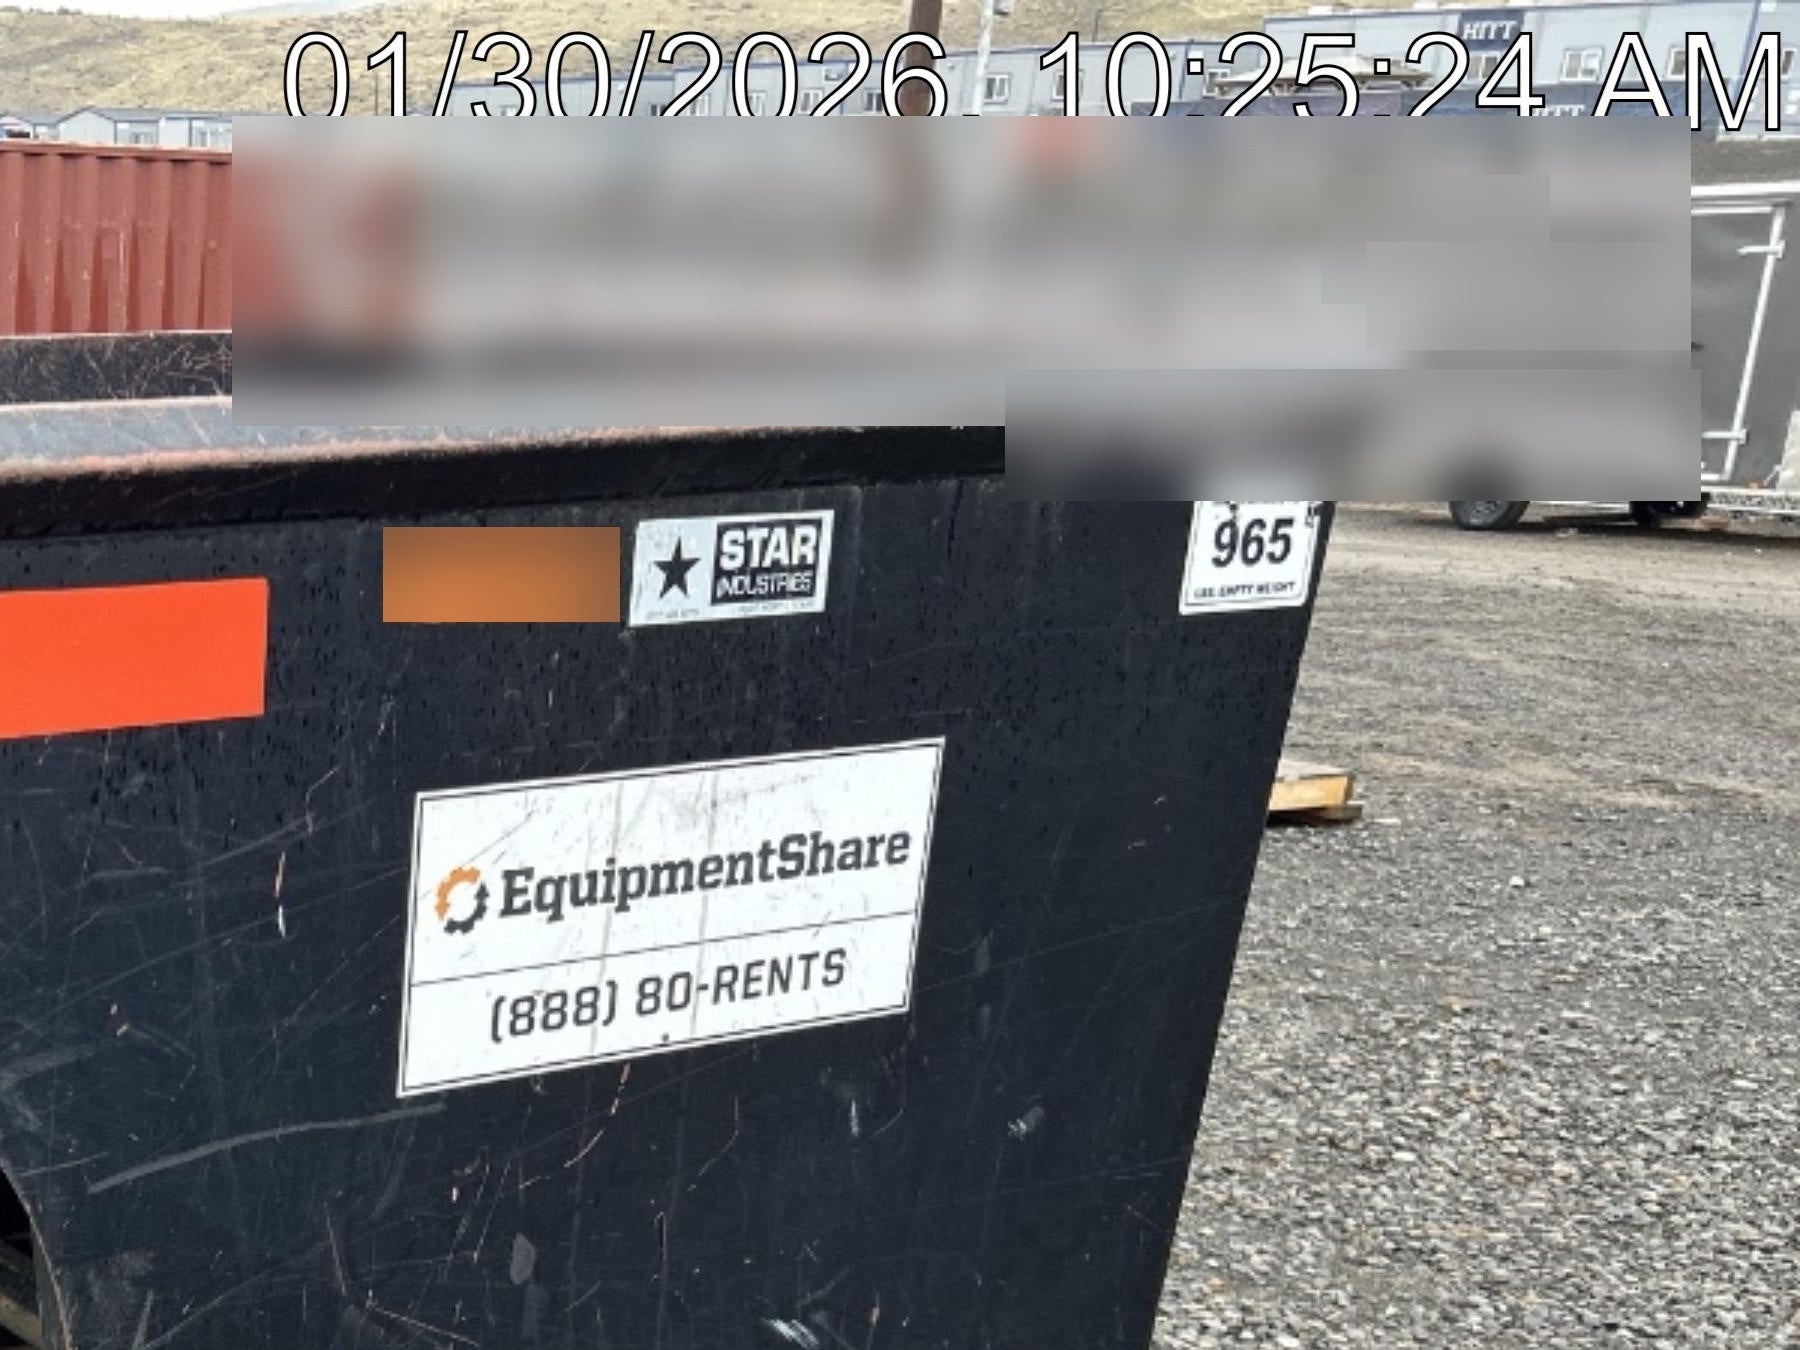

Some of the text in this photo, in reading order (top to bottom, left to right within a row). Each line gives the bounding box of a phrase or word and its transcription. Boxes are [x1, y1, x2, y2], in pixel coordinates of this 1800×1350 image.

[719, 525, 818, 571] STAR
[1211, 517, 1295, 568] 965
[715, 571, 814, 599] INDUSTRIES
[499, 830, 912, 923] EquipmentShare
[491, 948, 849, 1044] (888) 80-RENTS
